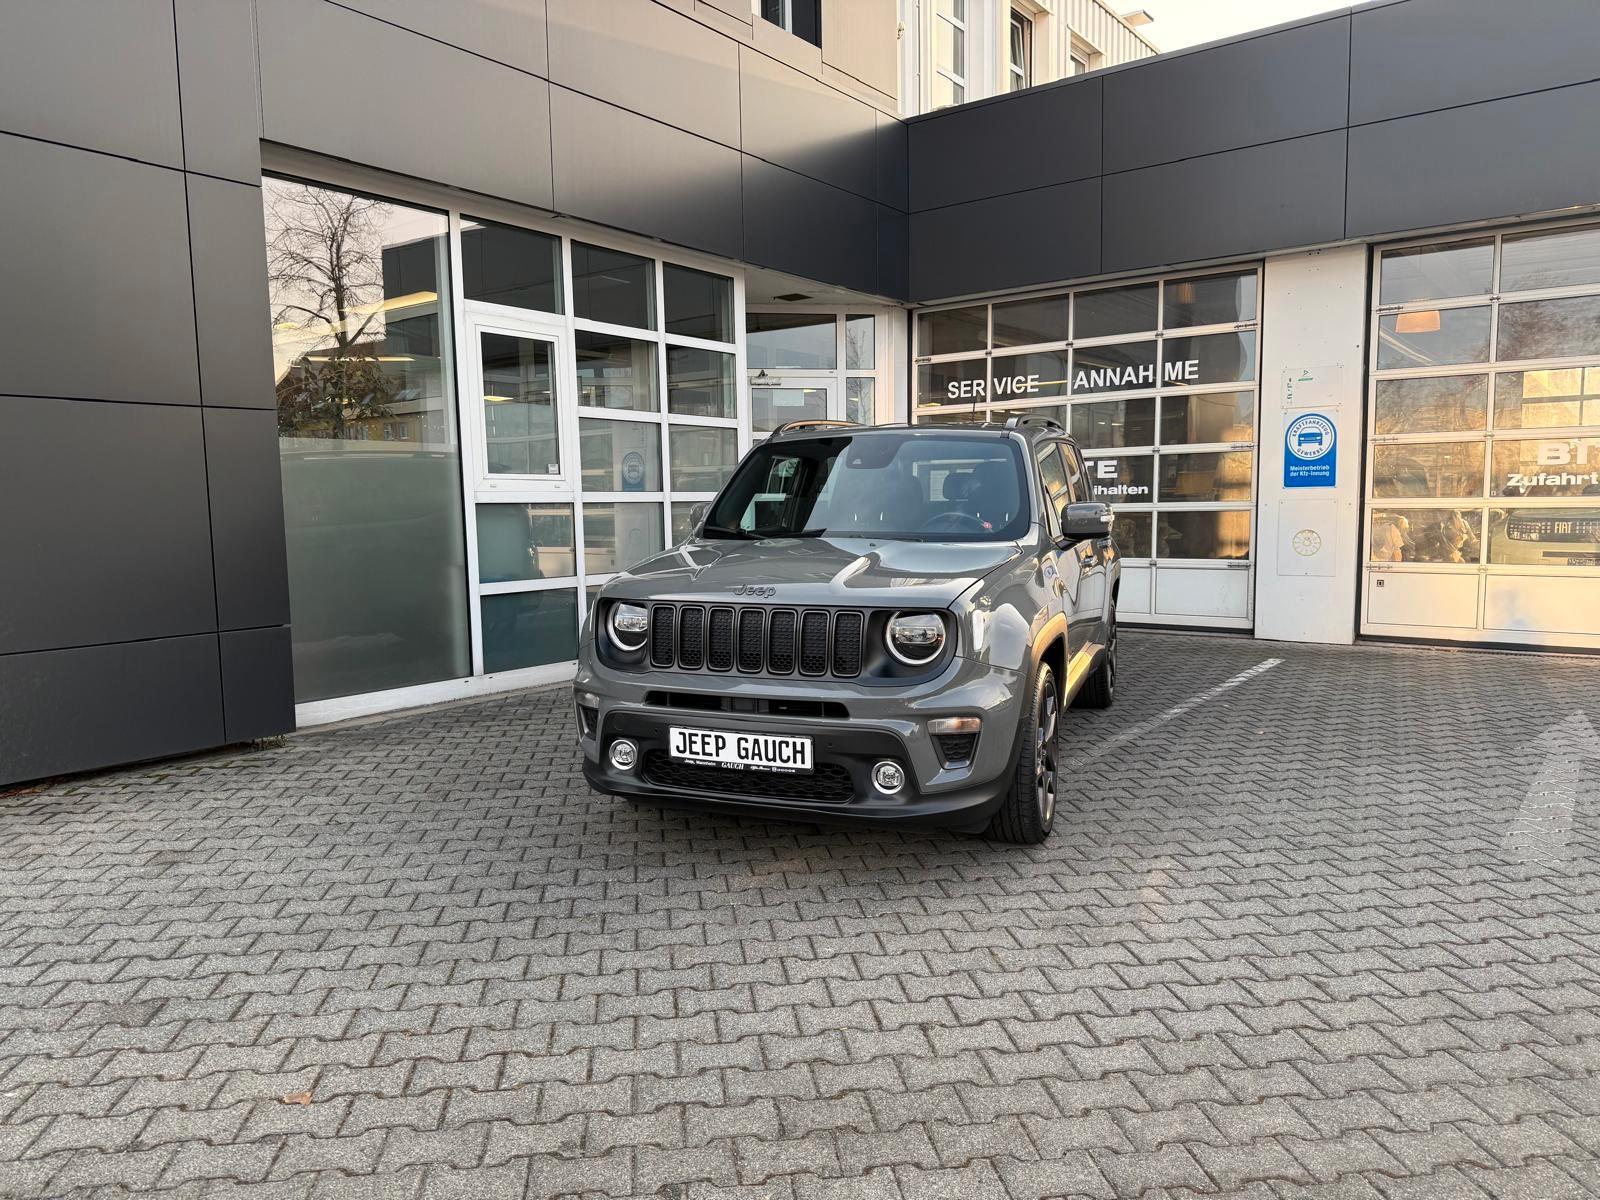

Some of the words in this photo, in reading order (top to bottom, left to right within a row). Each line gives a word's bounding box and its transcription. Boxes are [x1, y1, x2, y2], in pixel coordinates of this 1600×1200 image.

[1292, 420, 1330, 437] KRAFTFAHRZEUG
[1297, 447, 1324, 457] GEWERBE
[1507, 472, 1598, 487] Zufahrt
[1554, 521, 1573, 534] FIAT
[733, 583, 777, 599] Jeep
[675, 731, 727, 758] JEEP
[736, 737, 806, 765] GAUCH
[721, 761, 744, 771] GAUCH
